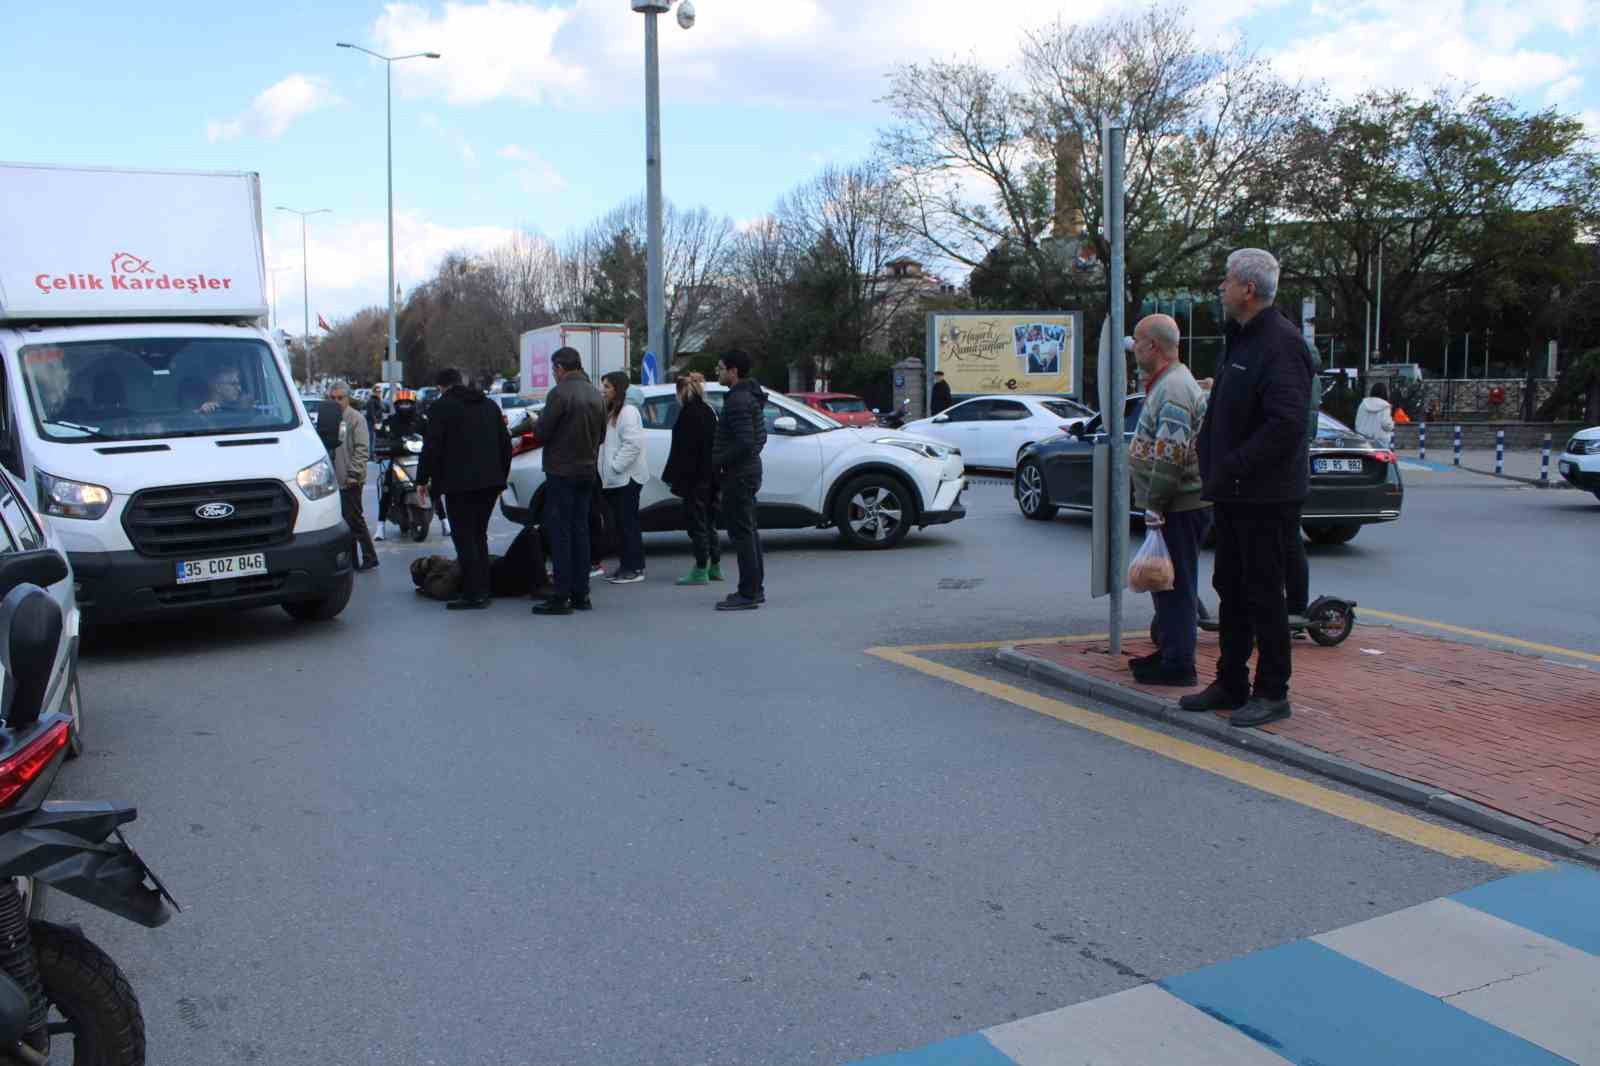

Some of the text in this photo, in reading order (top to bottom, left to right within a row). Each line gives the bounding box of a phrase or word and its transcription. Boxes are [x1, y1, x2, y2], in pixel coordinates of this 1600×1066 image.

[35, 273, 232, 295] Çelik Kardeşler
[201, 504, 228, 516] Ford
[185, 555, 262, 576] 35 COZ 846
